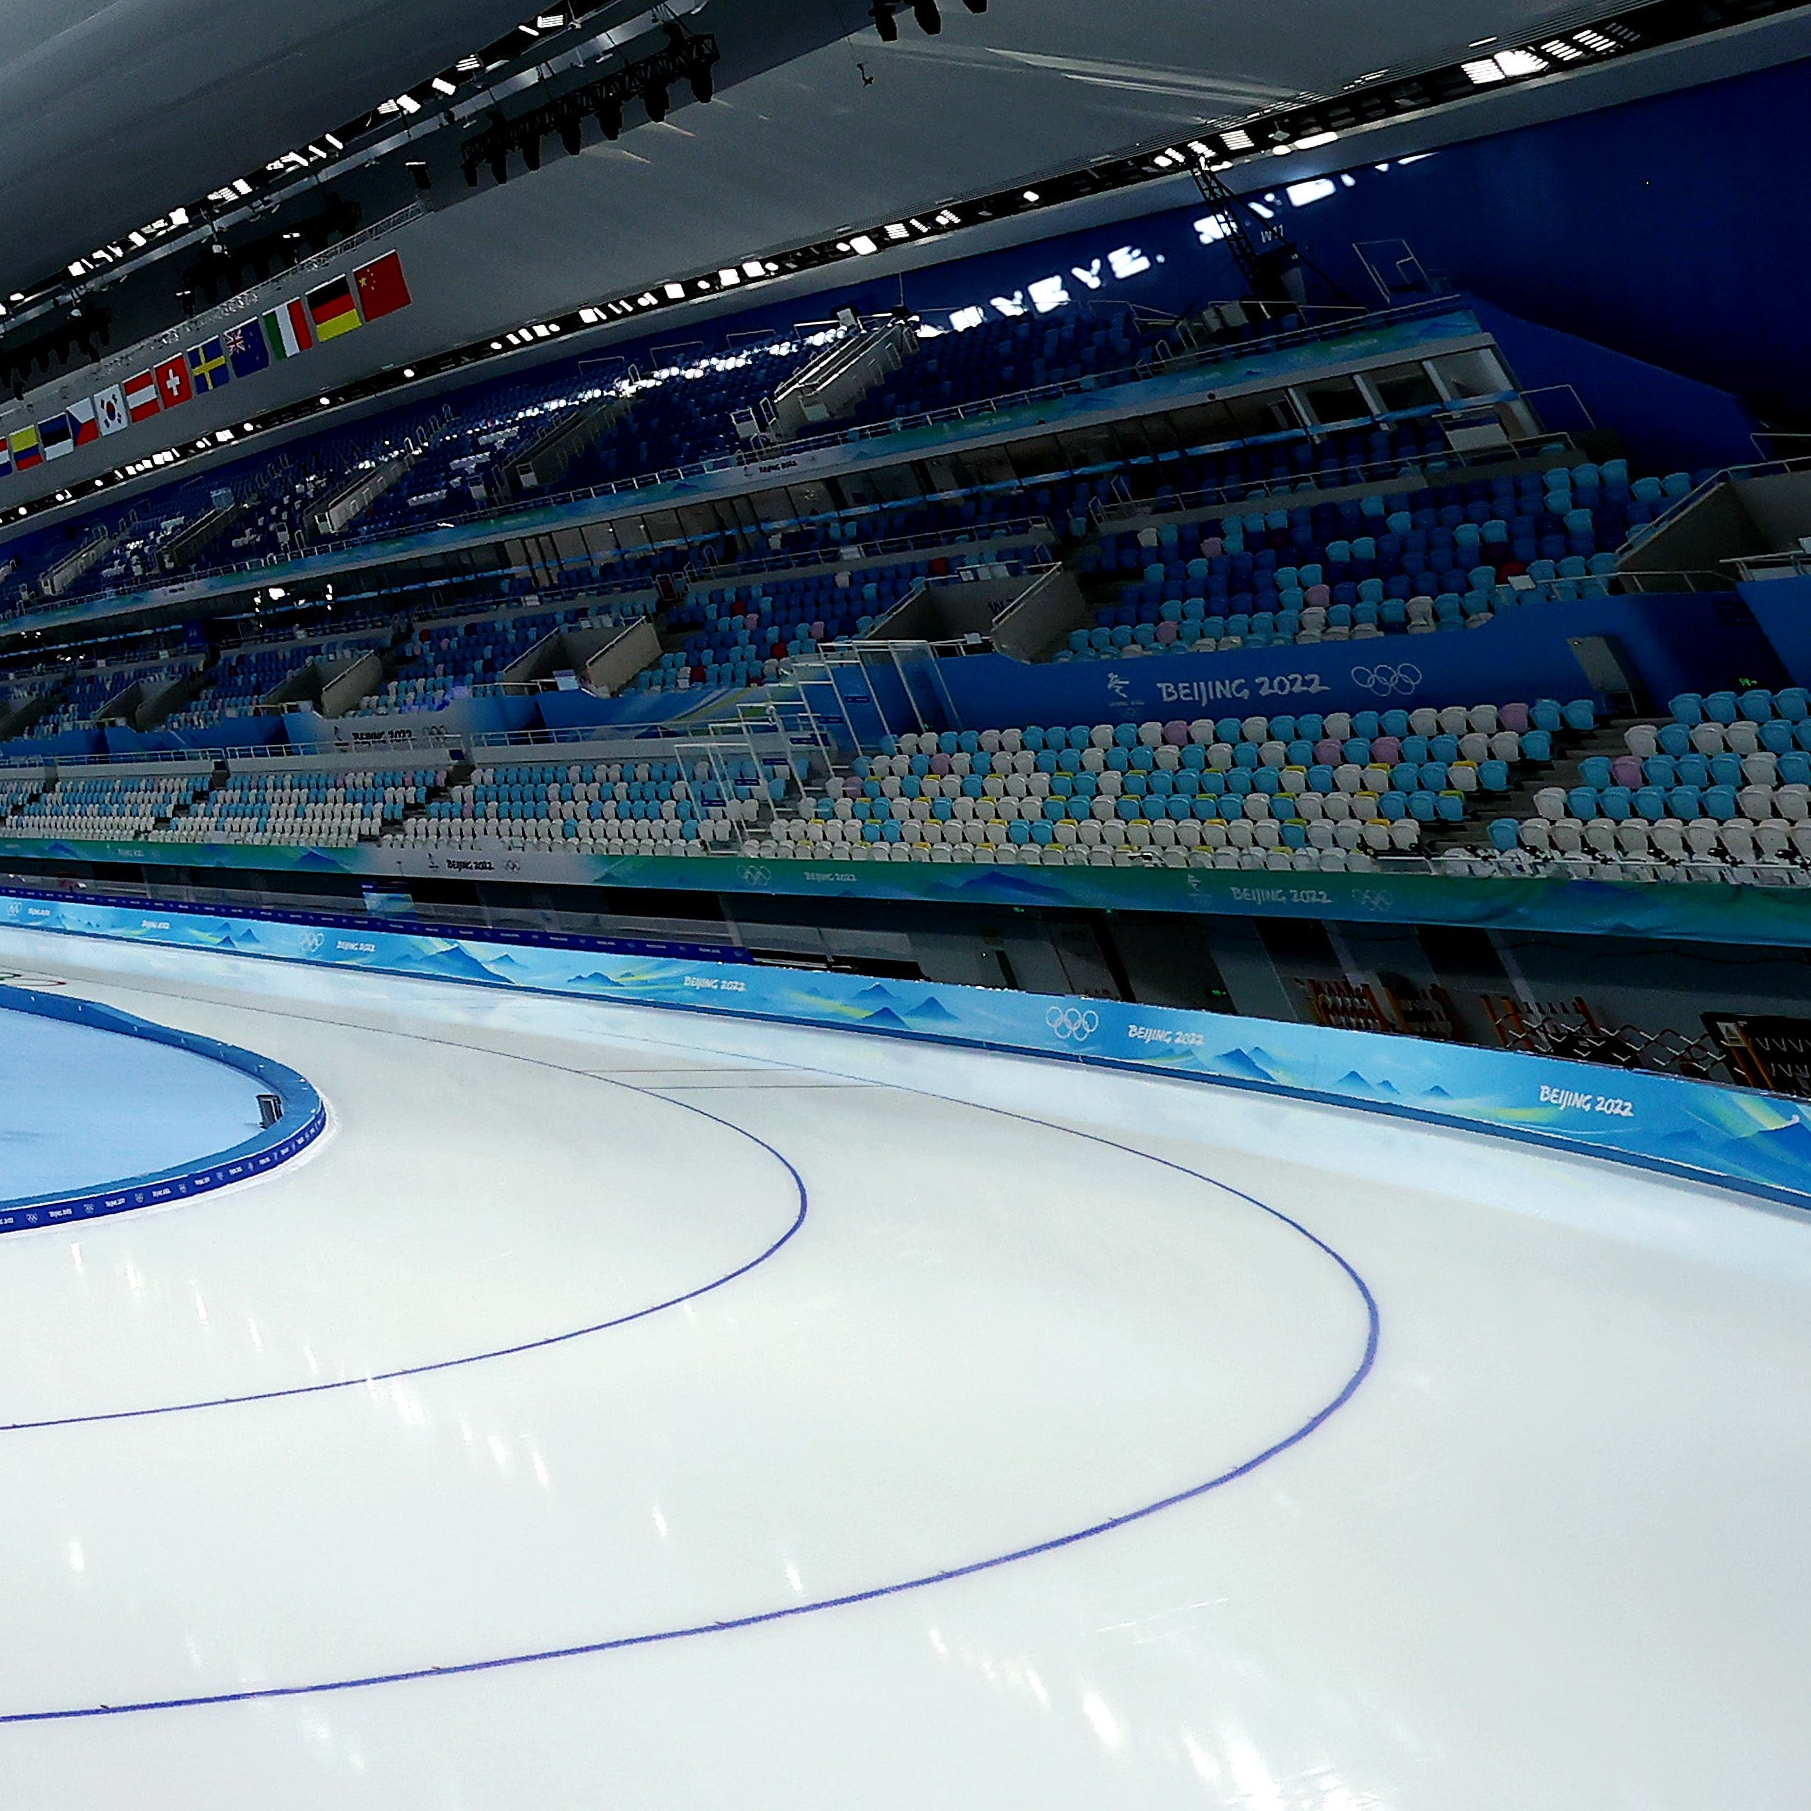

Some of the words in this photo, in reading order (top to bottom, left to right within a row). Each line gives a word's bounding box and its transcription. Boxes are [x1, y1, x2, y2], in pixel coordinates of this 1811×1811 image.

[1157, 679, 1250, 707] BEIJING
[1256, 674, 1331, 697] 2022
[447, 861, 473, 872] BEIJING
[475, 862, 495, 871] 2022
[804, 872, 835, 882] BEIJING
[837, 874, 857, 882] 2022
[1232, 888, 1286, 905] BEIJING
[1290, 891, 1332, 904] 2022
[684, 976, 718, 990] BEIJING
[721, 980, 746, 992] 2022
[1129, 1025, 1173, 1044] BEIJING
[1176, 1032, 1204, 1046] 2022
[1539, 1085, 1592, 1110] BEIJING
[1596, 1095, 1633, 1117] 2022
